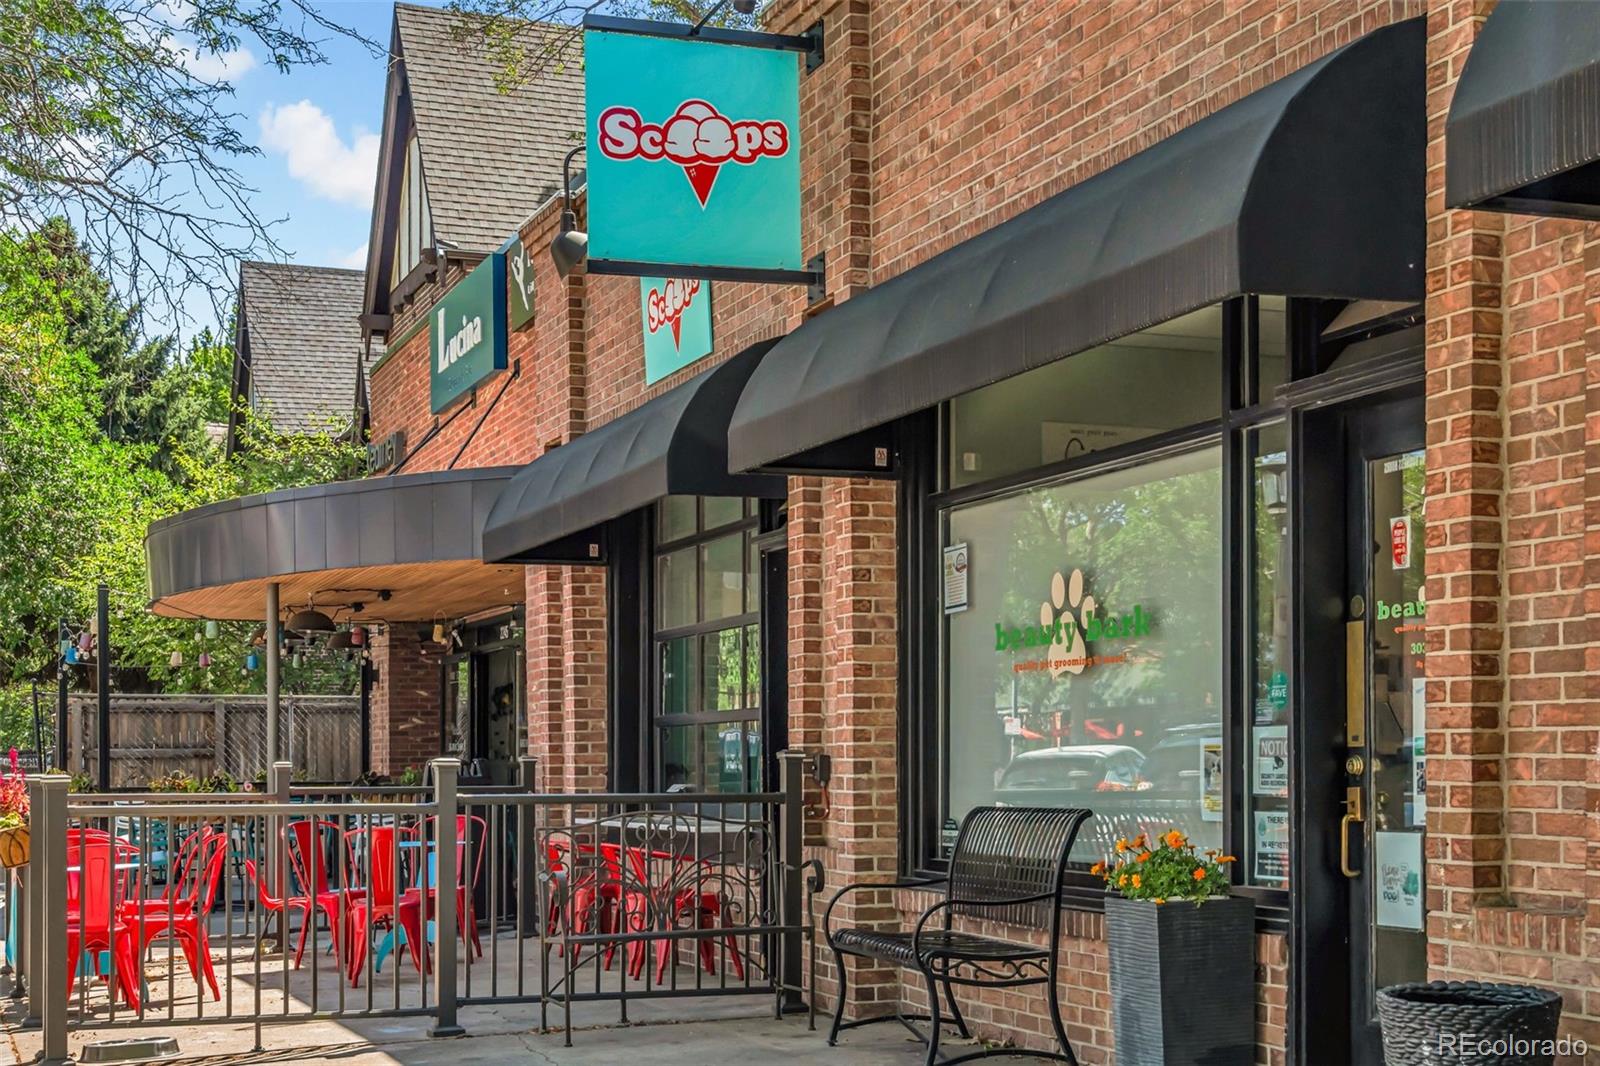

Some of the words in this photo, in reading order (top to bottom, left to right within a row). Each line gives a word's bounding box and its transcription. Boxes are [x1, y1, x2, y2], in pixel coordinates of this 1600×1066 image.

[598, 98, 789, 166] Scoops
[437, 307, 482, 374] Lucina
[995, 617, 1077, 653] beauty
[1086, 604, 1152, 640] bark
[1040, 660, 1053, 670] pet
[1054, 653, 1092, 669] grooming
[1271, 688, 1287, 698] FAVE
[1267, 816, 1284, 824] THERE
